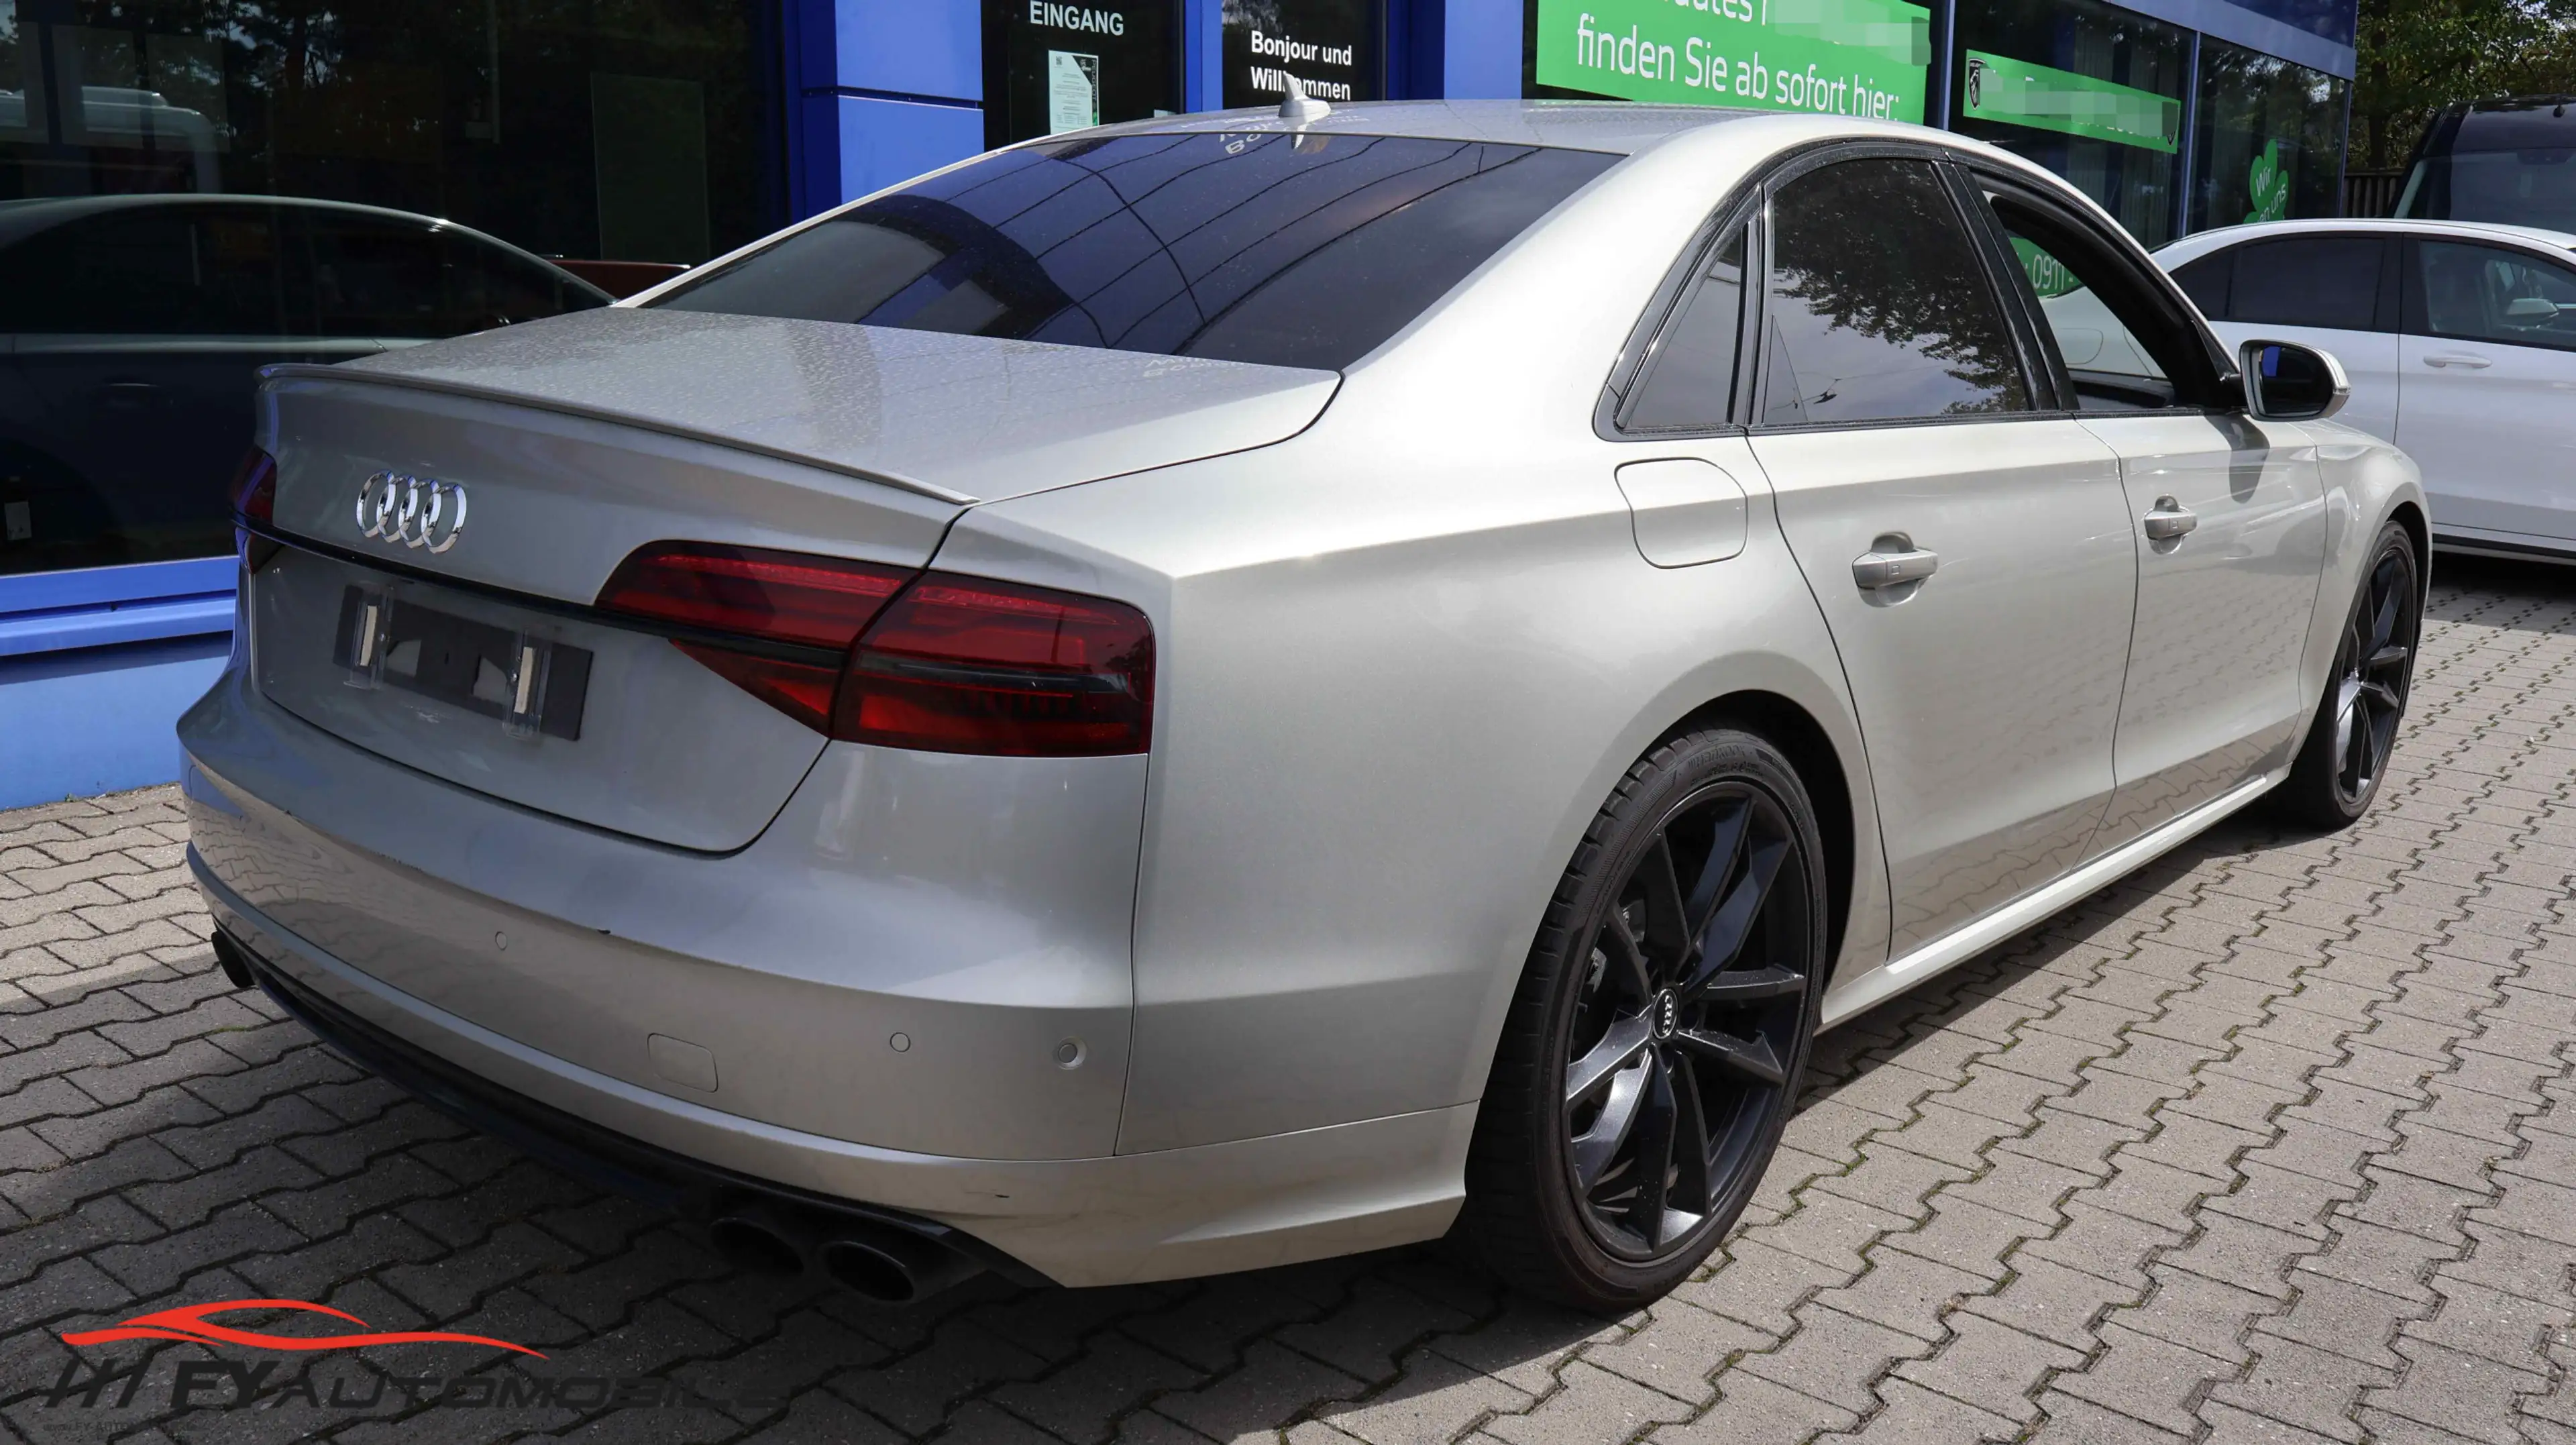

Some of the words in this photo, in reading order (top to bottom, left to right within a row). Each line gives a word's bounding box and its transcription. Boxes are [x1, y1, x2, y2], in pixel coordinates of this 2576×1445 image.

[1030, 1, 1124, 36] EINGANG
[1251, 30, 1318, 63] Bonjour
[1323, 45, 1352, 66] und
[1577, 13, 1674, 81] finden
[1684, 38, 1727, 92] Sie
[1735, 52, 1768, 99] ab
[1775, 64, 1847, 115] sofort
[1853, 74, 1899, 121] hier:
[2255, 166, 2271, 197] Wir
[2270, 182, 2287, 214] uns
